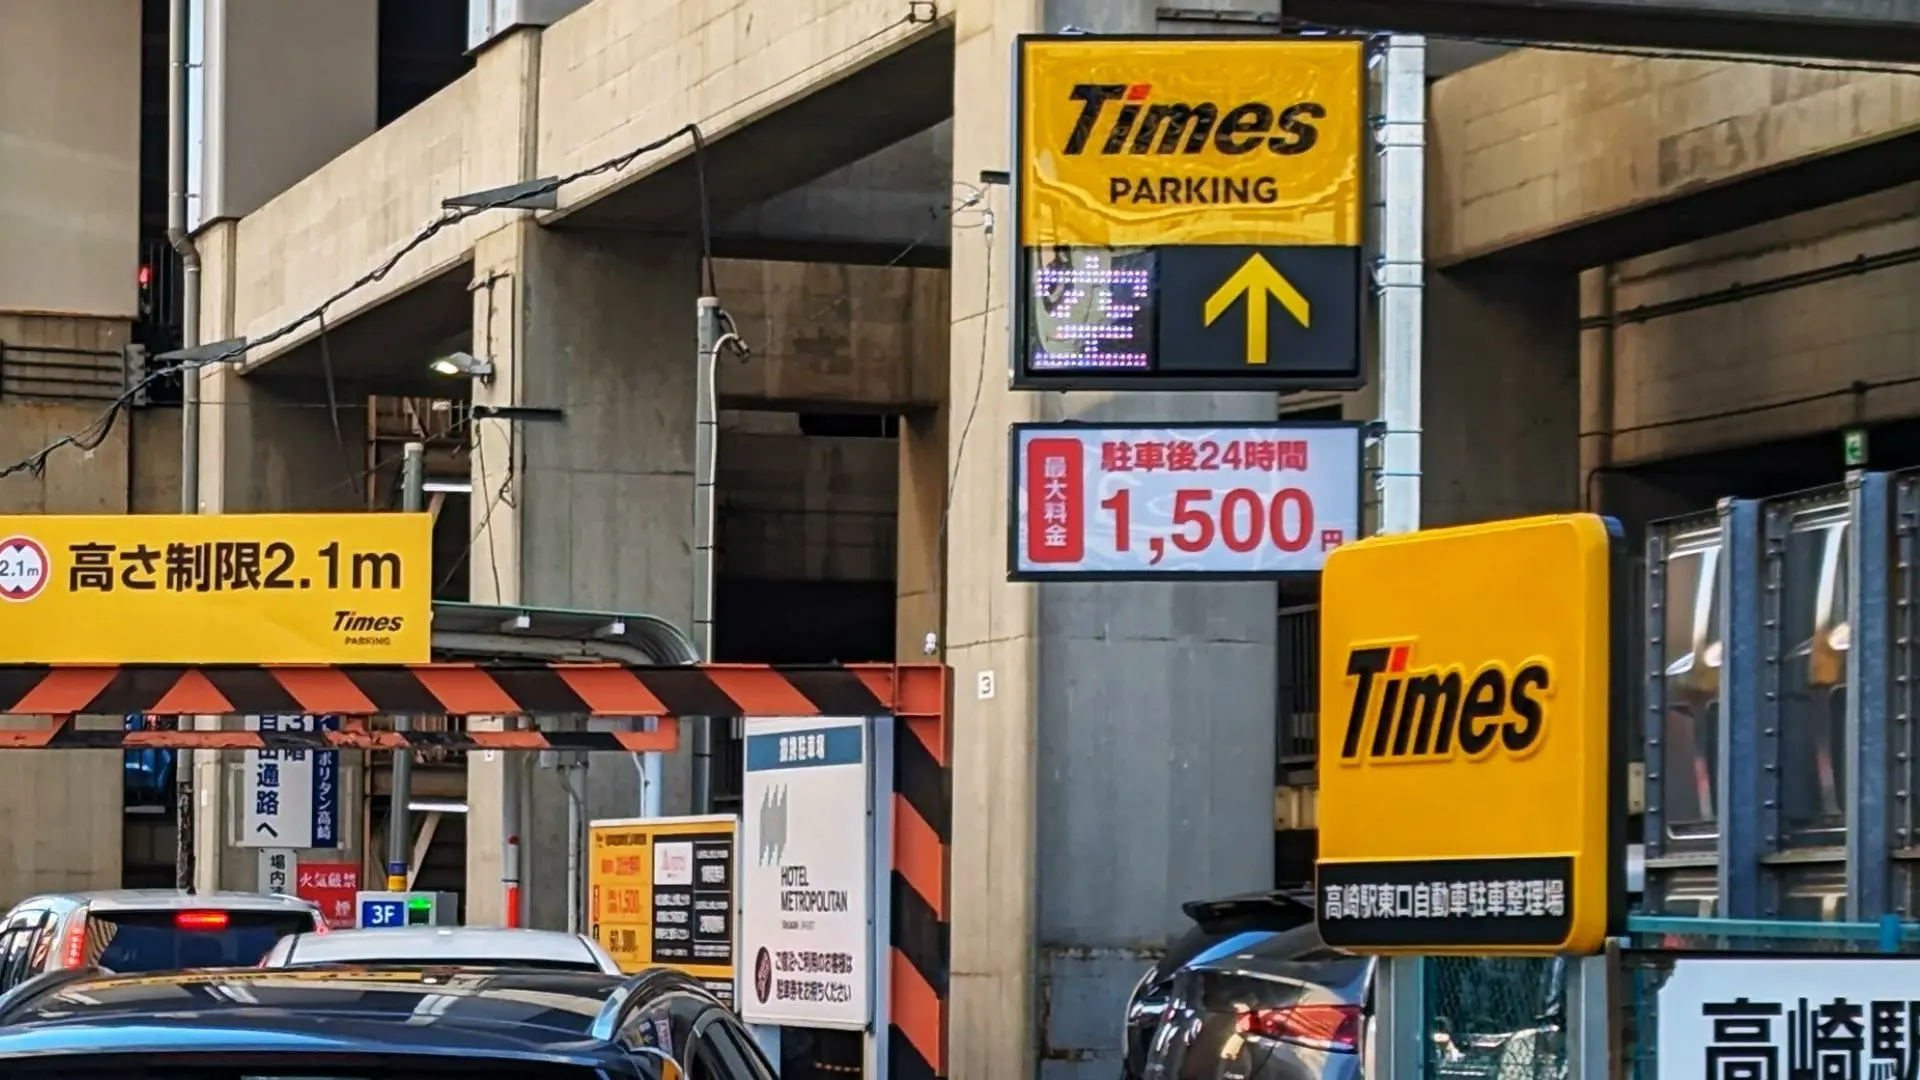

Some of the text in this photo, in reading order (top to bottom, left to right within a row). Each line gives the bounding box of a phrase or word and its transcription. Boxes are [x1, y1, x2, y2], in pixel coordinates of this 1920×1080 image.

[1063, 83, 1327, 156] Times
[1110, 177, 1278, 205] PARKING
[1034, 256, 1148, 367] 空
[1101, 440, 1308, 473] 駐車後24時間
[1043, 456, 1068, 548] 最大料金
[0, 560, 39, 578] 2.1m
[69, 541, 402, 592] 高さ制限2.1m
[332, 610, 405, 633] Times
[345, 636, 391, 646] PARKING
[981, 675, 992, 696] 3
[1341, 645, 1549, 760] Times
[781, 866, 809, 887] HOTEL
[781, 891, 848, 912] METROPOLITAN
[1324, 879, 1565, 920] 高崎駅東口自動車駐車整理場
[371, 905, 395, 925] 3F
